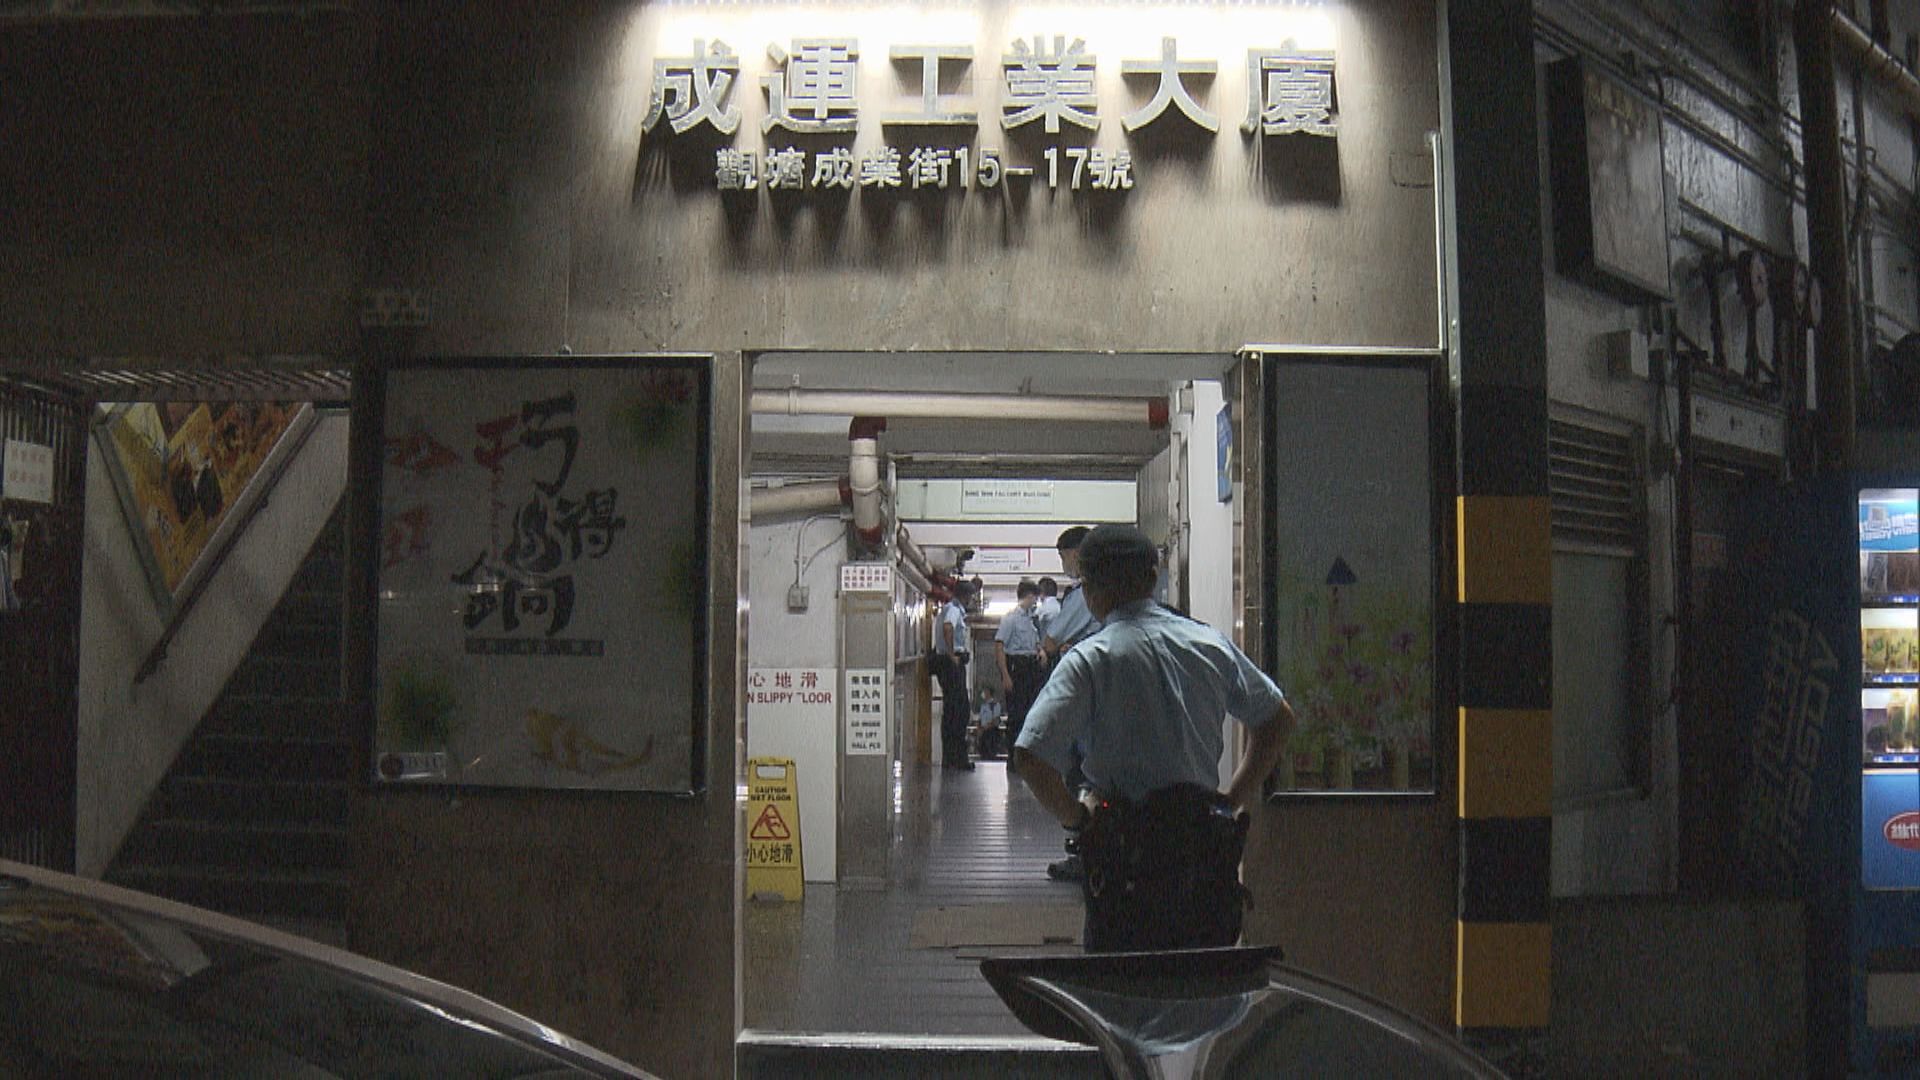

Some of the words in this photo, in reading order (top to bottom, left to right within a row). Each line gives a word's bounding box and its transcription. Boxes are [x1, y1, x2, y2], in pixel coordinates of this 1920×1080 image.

[641, 35, 1339, 136] 成運工業大廈
[749, 671, 818, 689] 心地滑
[757, 692, 793, 704] SLIPPY
[748, 843, 793, 863] 小心地滑
